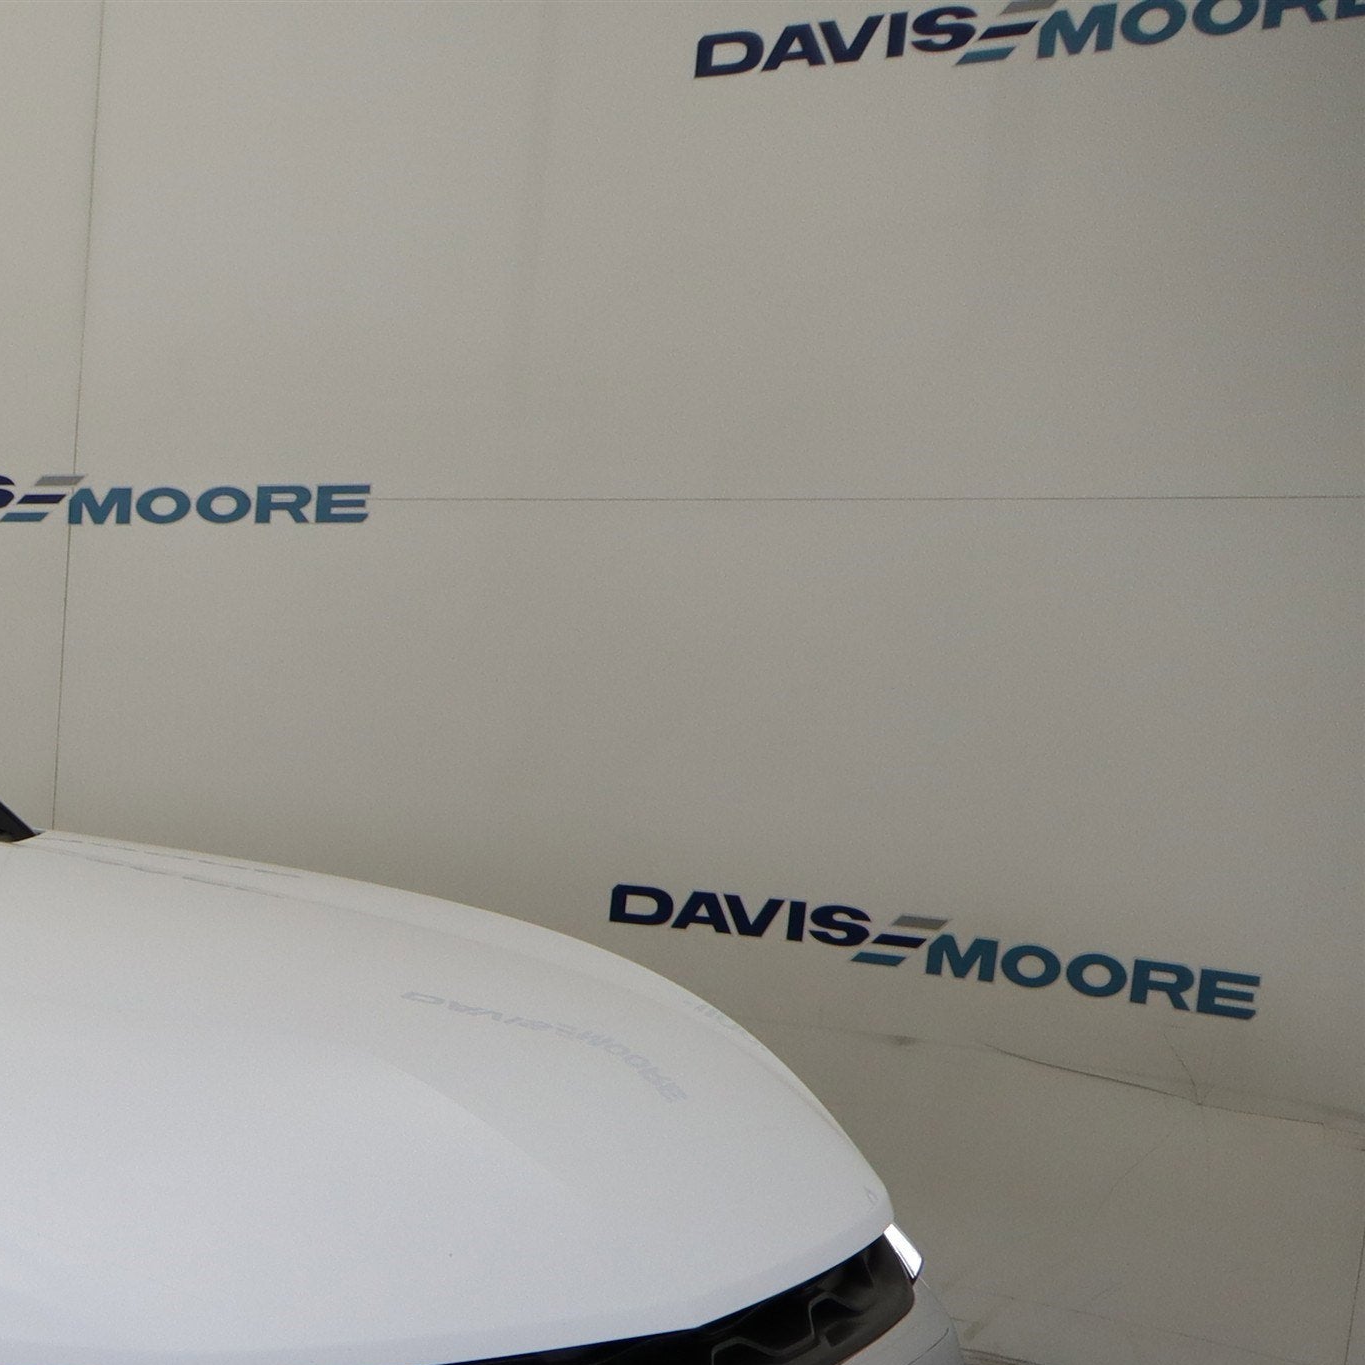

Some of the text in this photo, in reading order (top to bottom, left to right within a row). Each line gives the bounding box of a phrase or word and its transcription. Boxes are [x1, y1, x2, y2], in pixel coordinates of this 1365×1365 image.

[693, 6, 977, 78] DAVIS
[69, 484, 372, 525] MOORE
[608, 883, 1261, 1020] DAVIS MOORE
